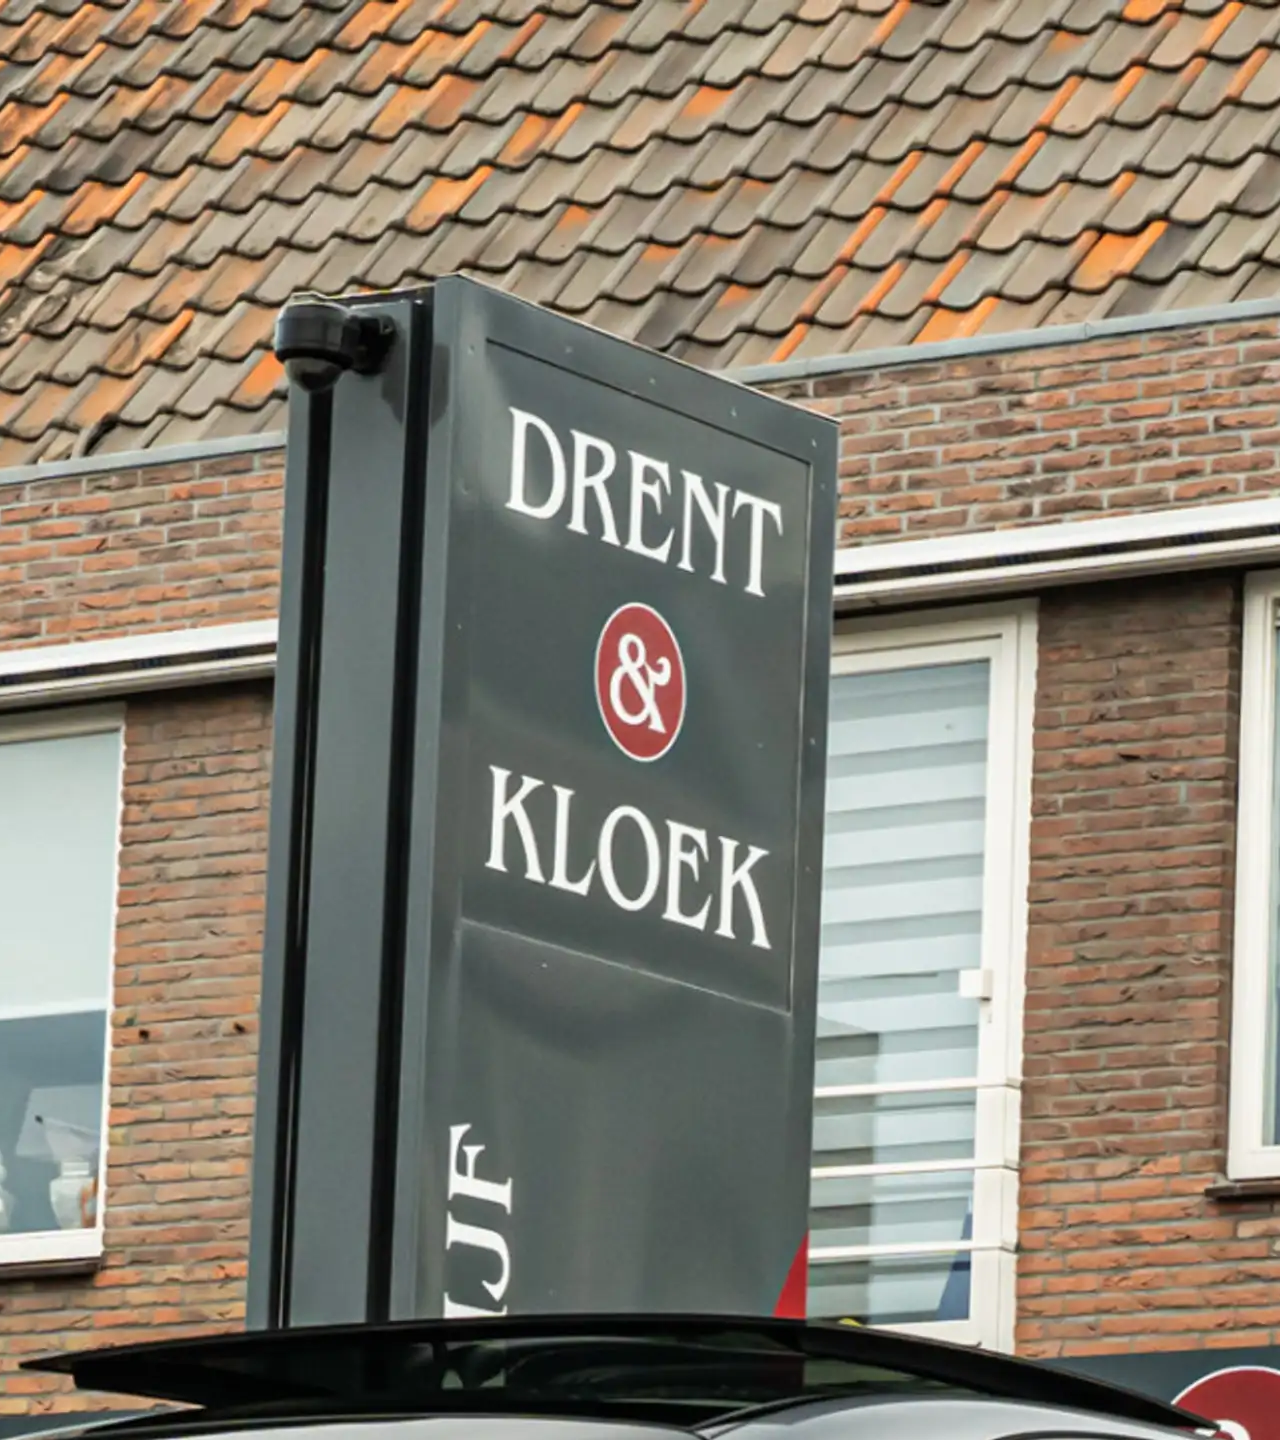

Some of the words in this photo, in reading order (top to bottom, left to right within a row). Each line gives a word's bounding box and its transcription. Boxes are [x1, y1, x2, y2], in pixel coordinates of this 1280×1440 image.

[504, 405, 784, 598] DRENT
[608, 632, 673, 735] &
[483, 763, 773, 951] KLOEK
